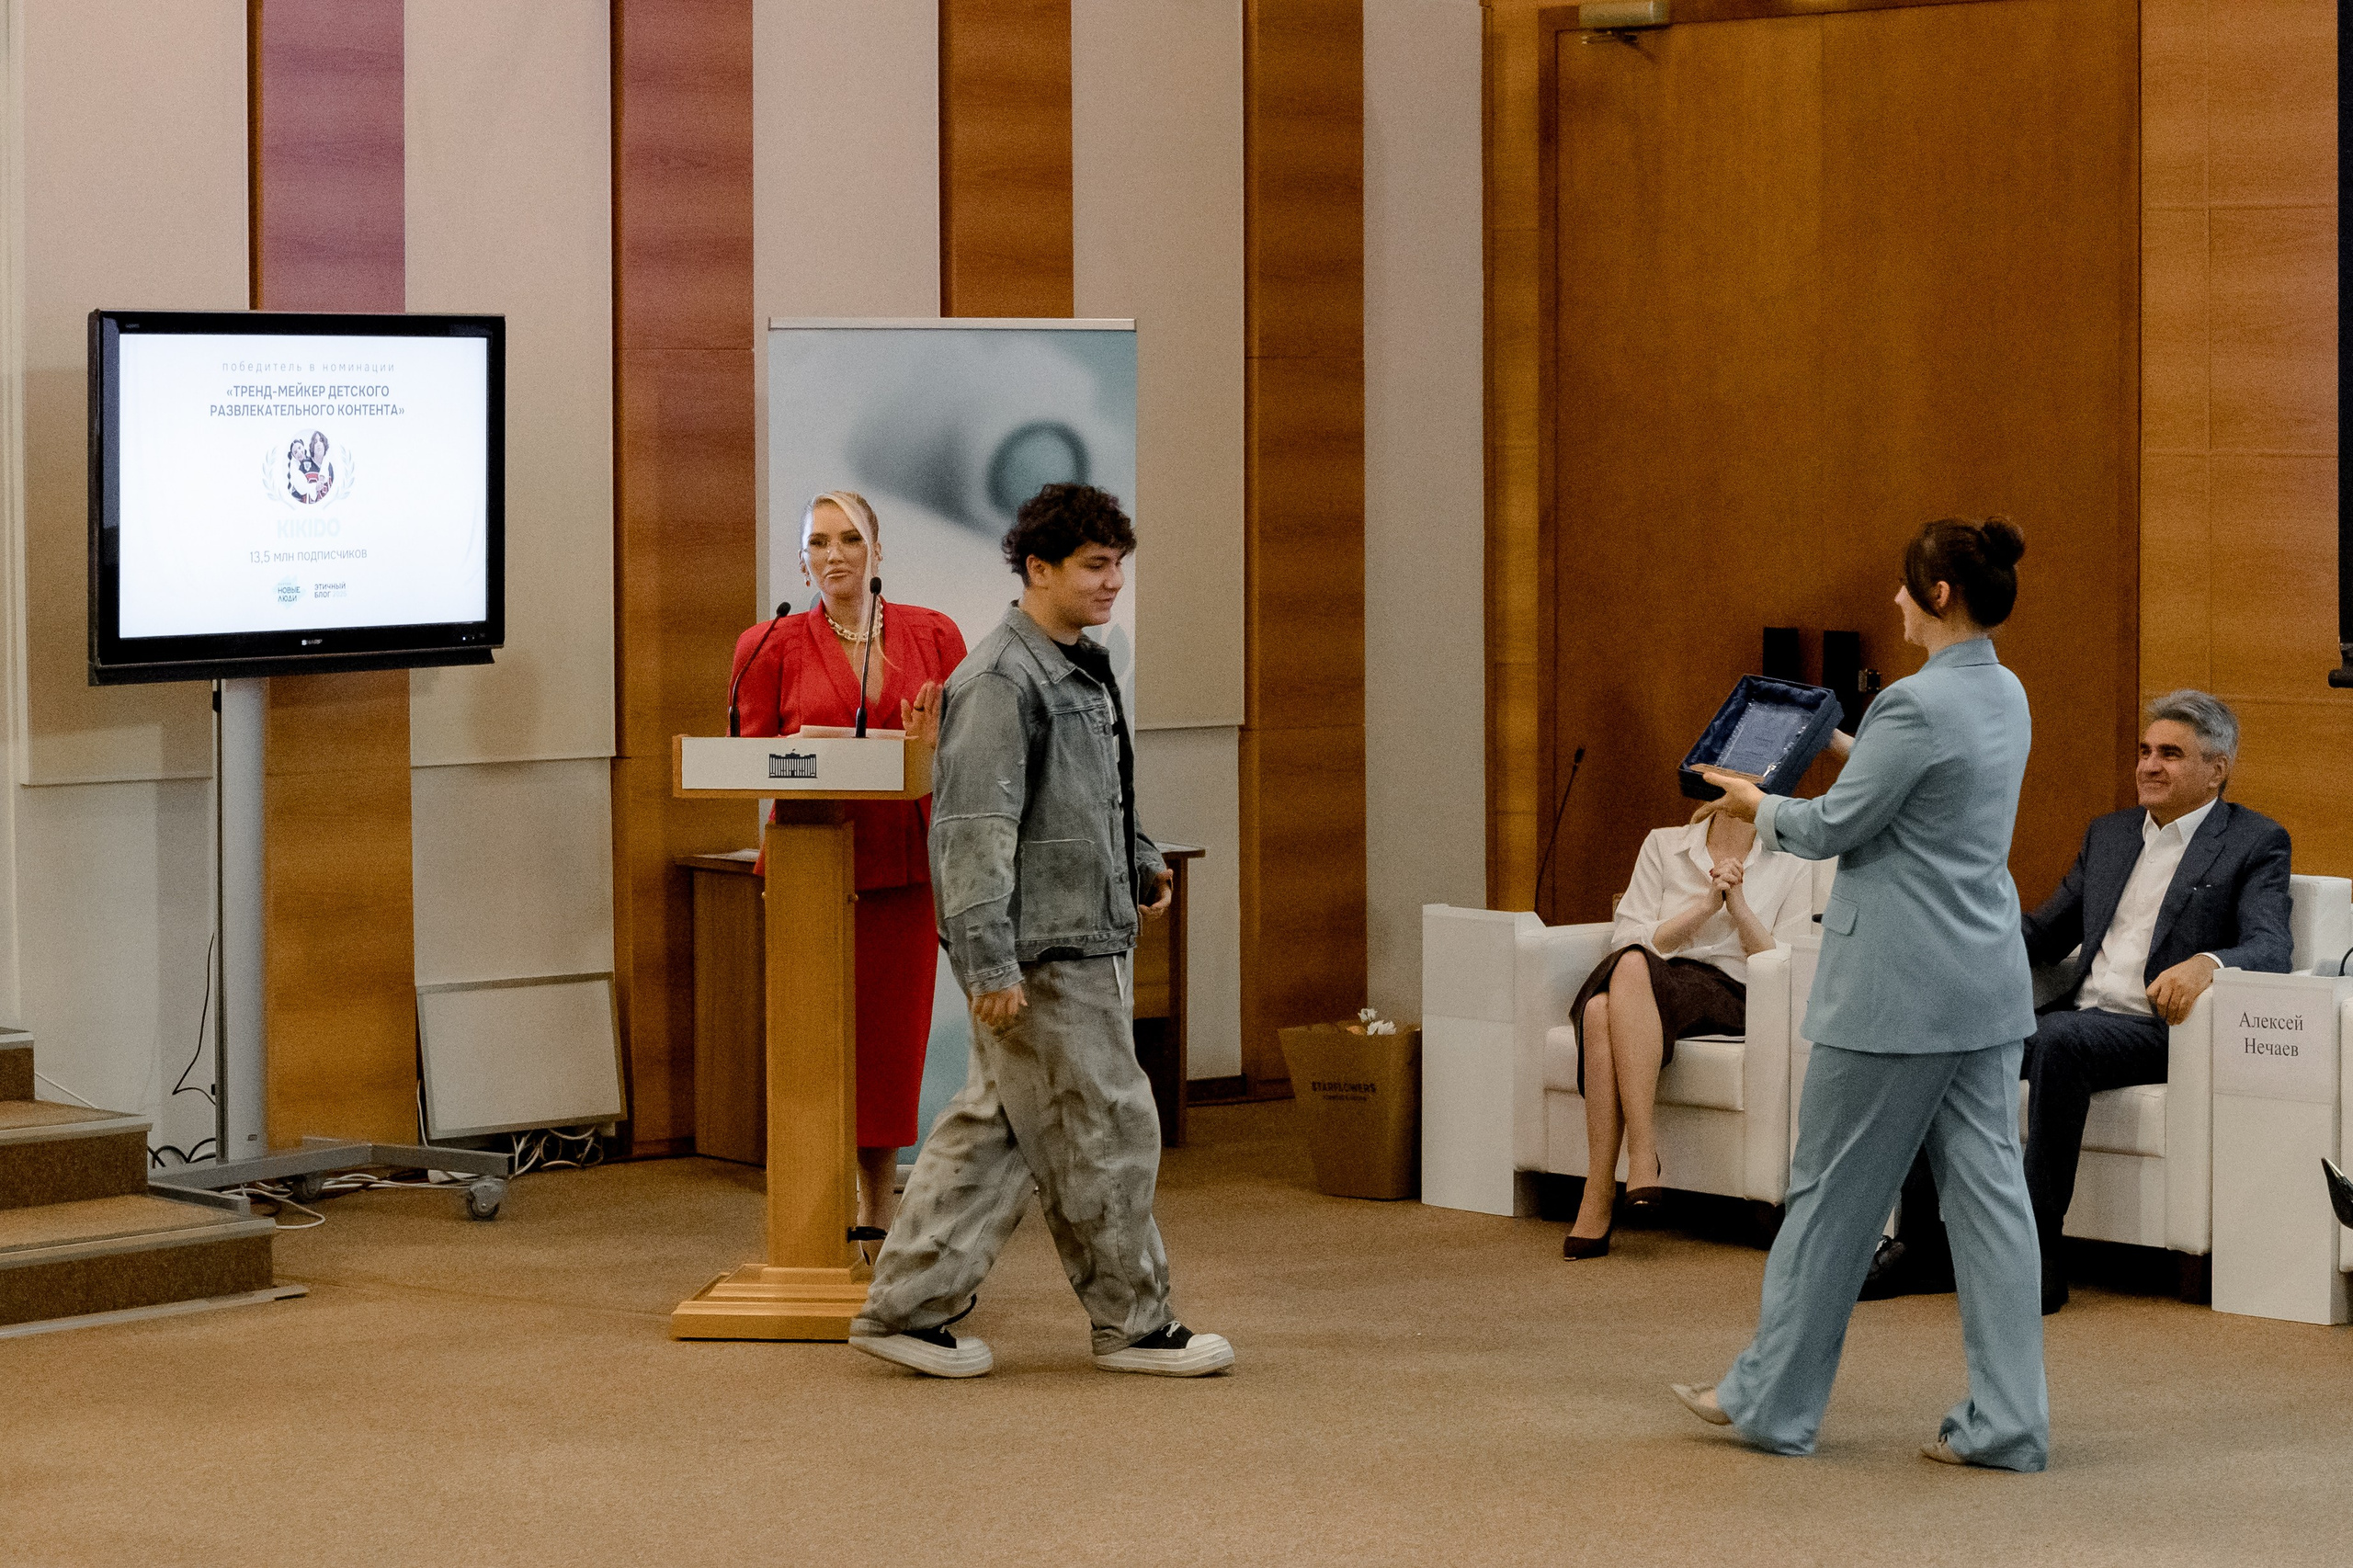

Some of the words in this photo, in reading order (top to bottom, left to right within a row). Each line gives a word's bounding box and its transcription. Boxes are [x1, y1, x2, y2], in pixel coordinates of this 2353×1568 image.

[222, 361, 301, 372] победитель
[323, 364, 394, 373] номинации
[226, 382, 325, 399] «ТРЕНД-МЕЙКЕР
[328, 385, 390, 399] ДЕТСКОГО
[210, 404, 335, 416] РАЗВЛЕКАТЕЛЬНОГО
[337, 404, 404, 415] КОНТЕНТА»
[278, 518, 341, 539] KIKIDO
[250, 551, 270, 563] 13,5
[2239, 1012, 2303, 1030] Алексей
[2244, 1038, 2299, 1057] Нечаев
